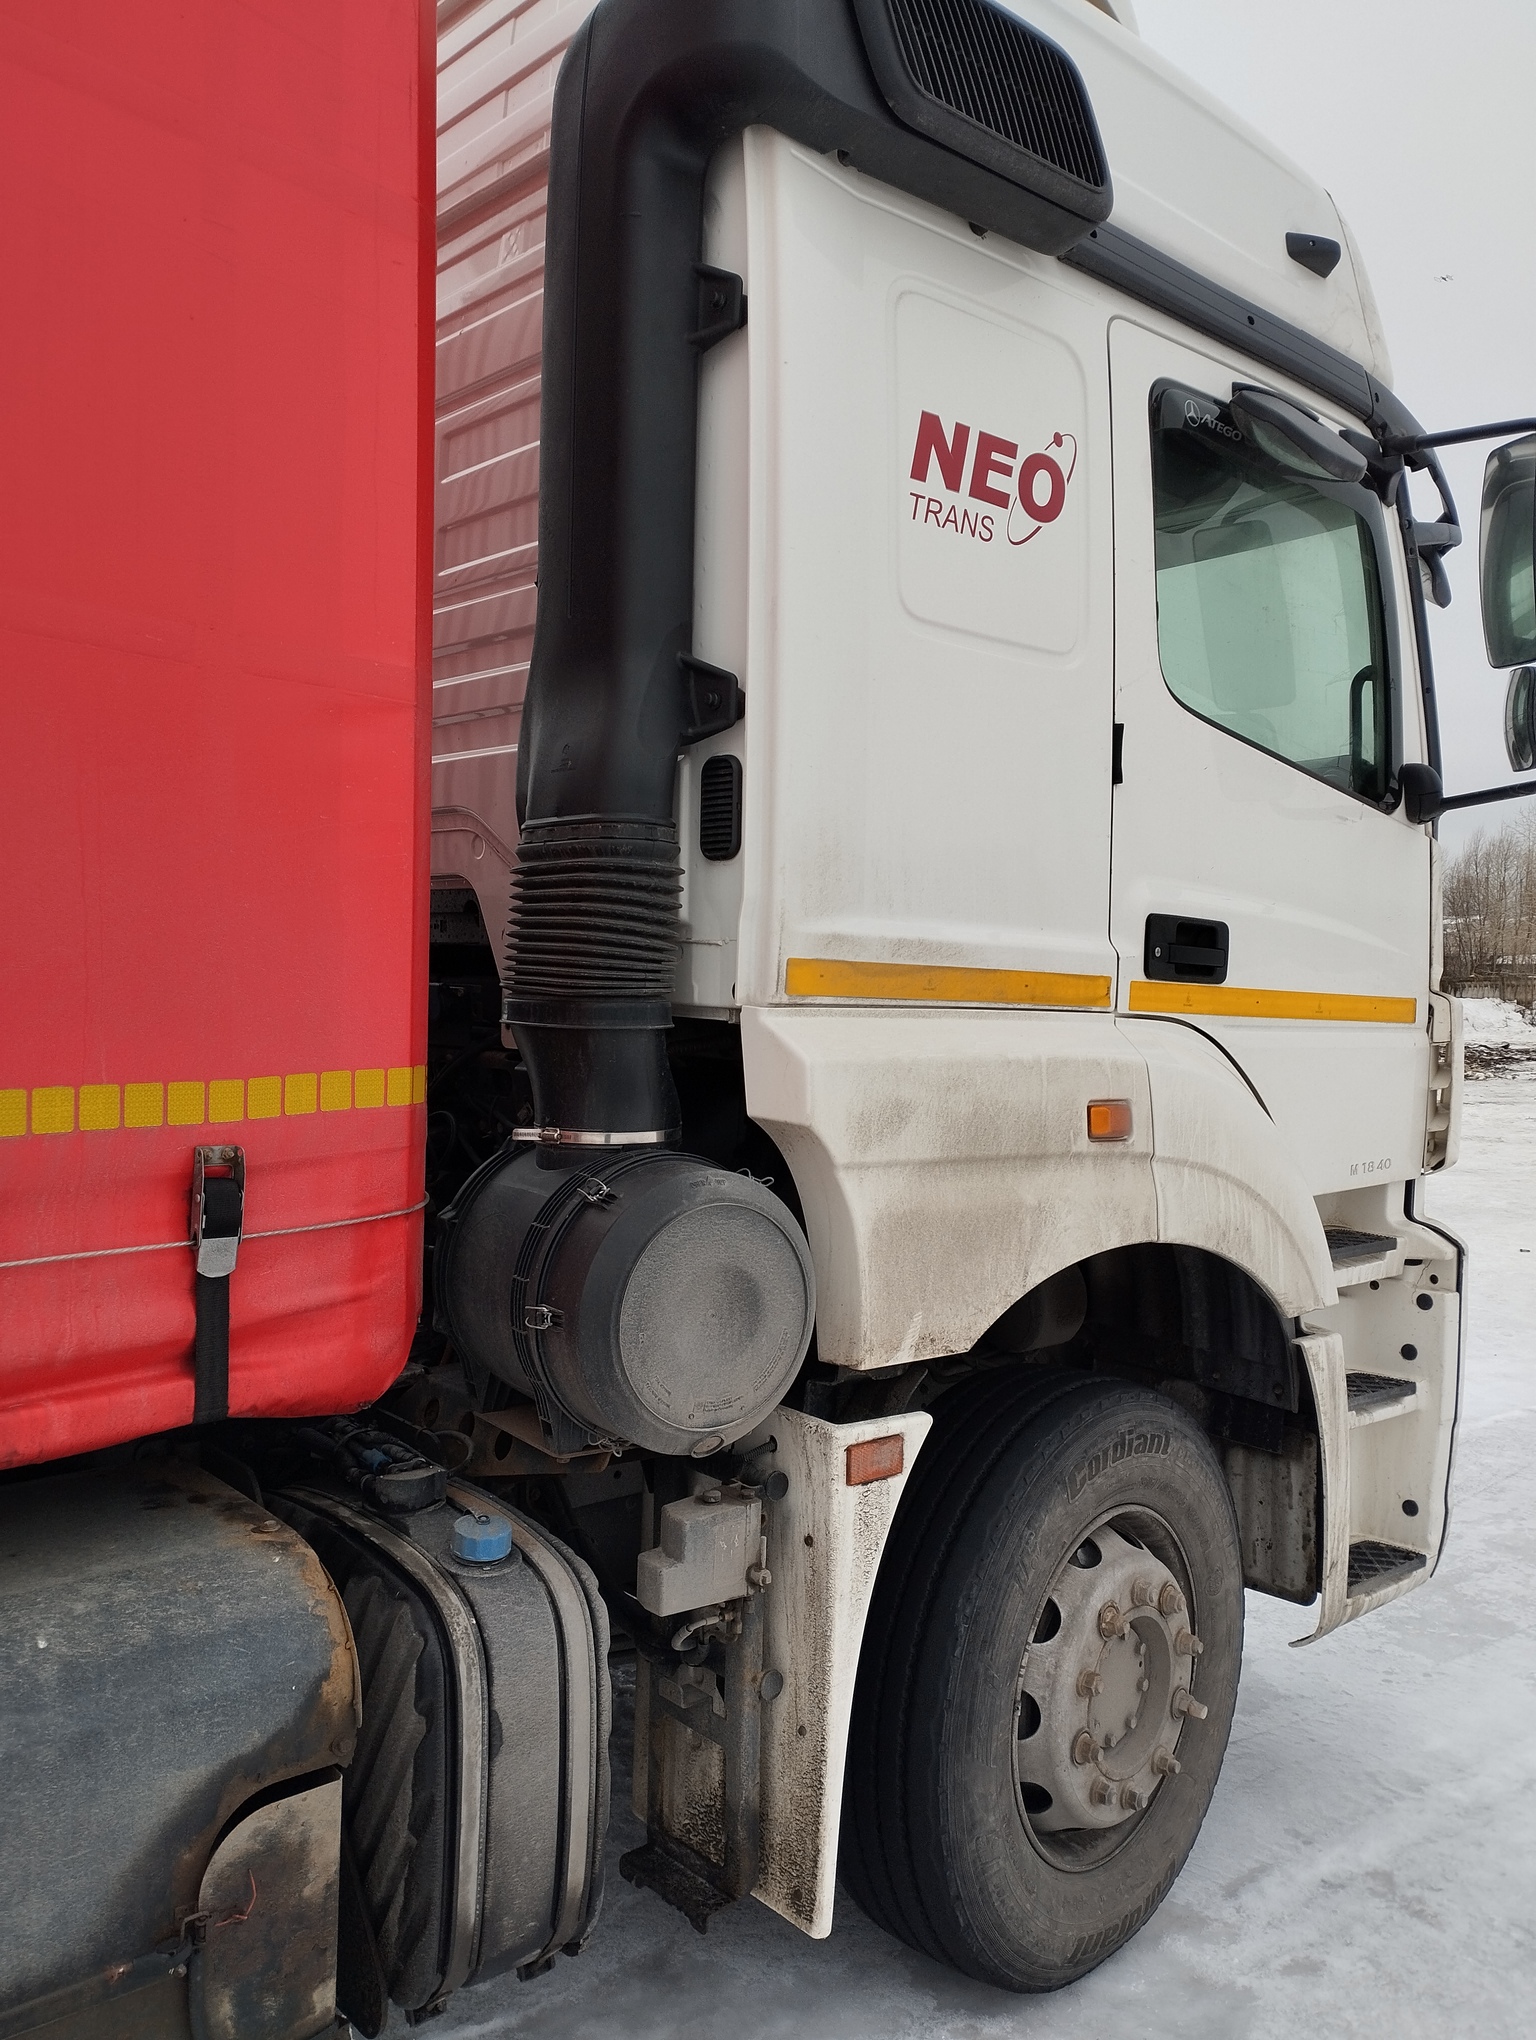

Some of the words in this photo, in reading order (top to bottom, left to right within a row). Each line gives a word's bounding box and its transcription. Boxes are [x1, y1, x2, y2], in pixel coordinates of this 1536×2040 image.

[1200, 413, 1242, 441] ATEGO
[909, 410, 1066, 524] NEO
[909, 492, 994, 543] TRANS
[1066, 1427, 1172, 1504] Cordiant
